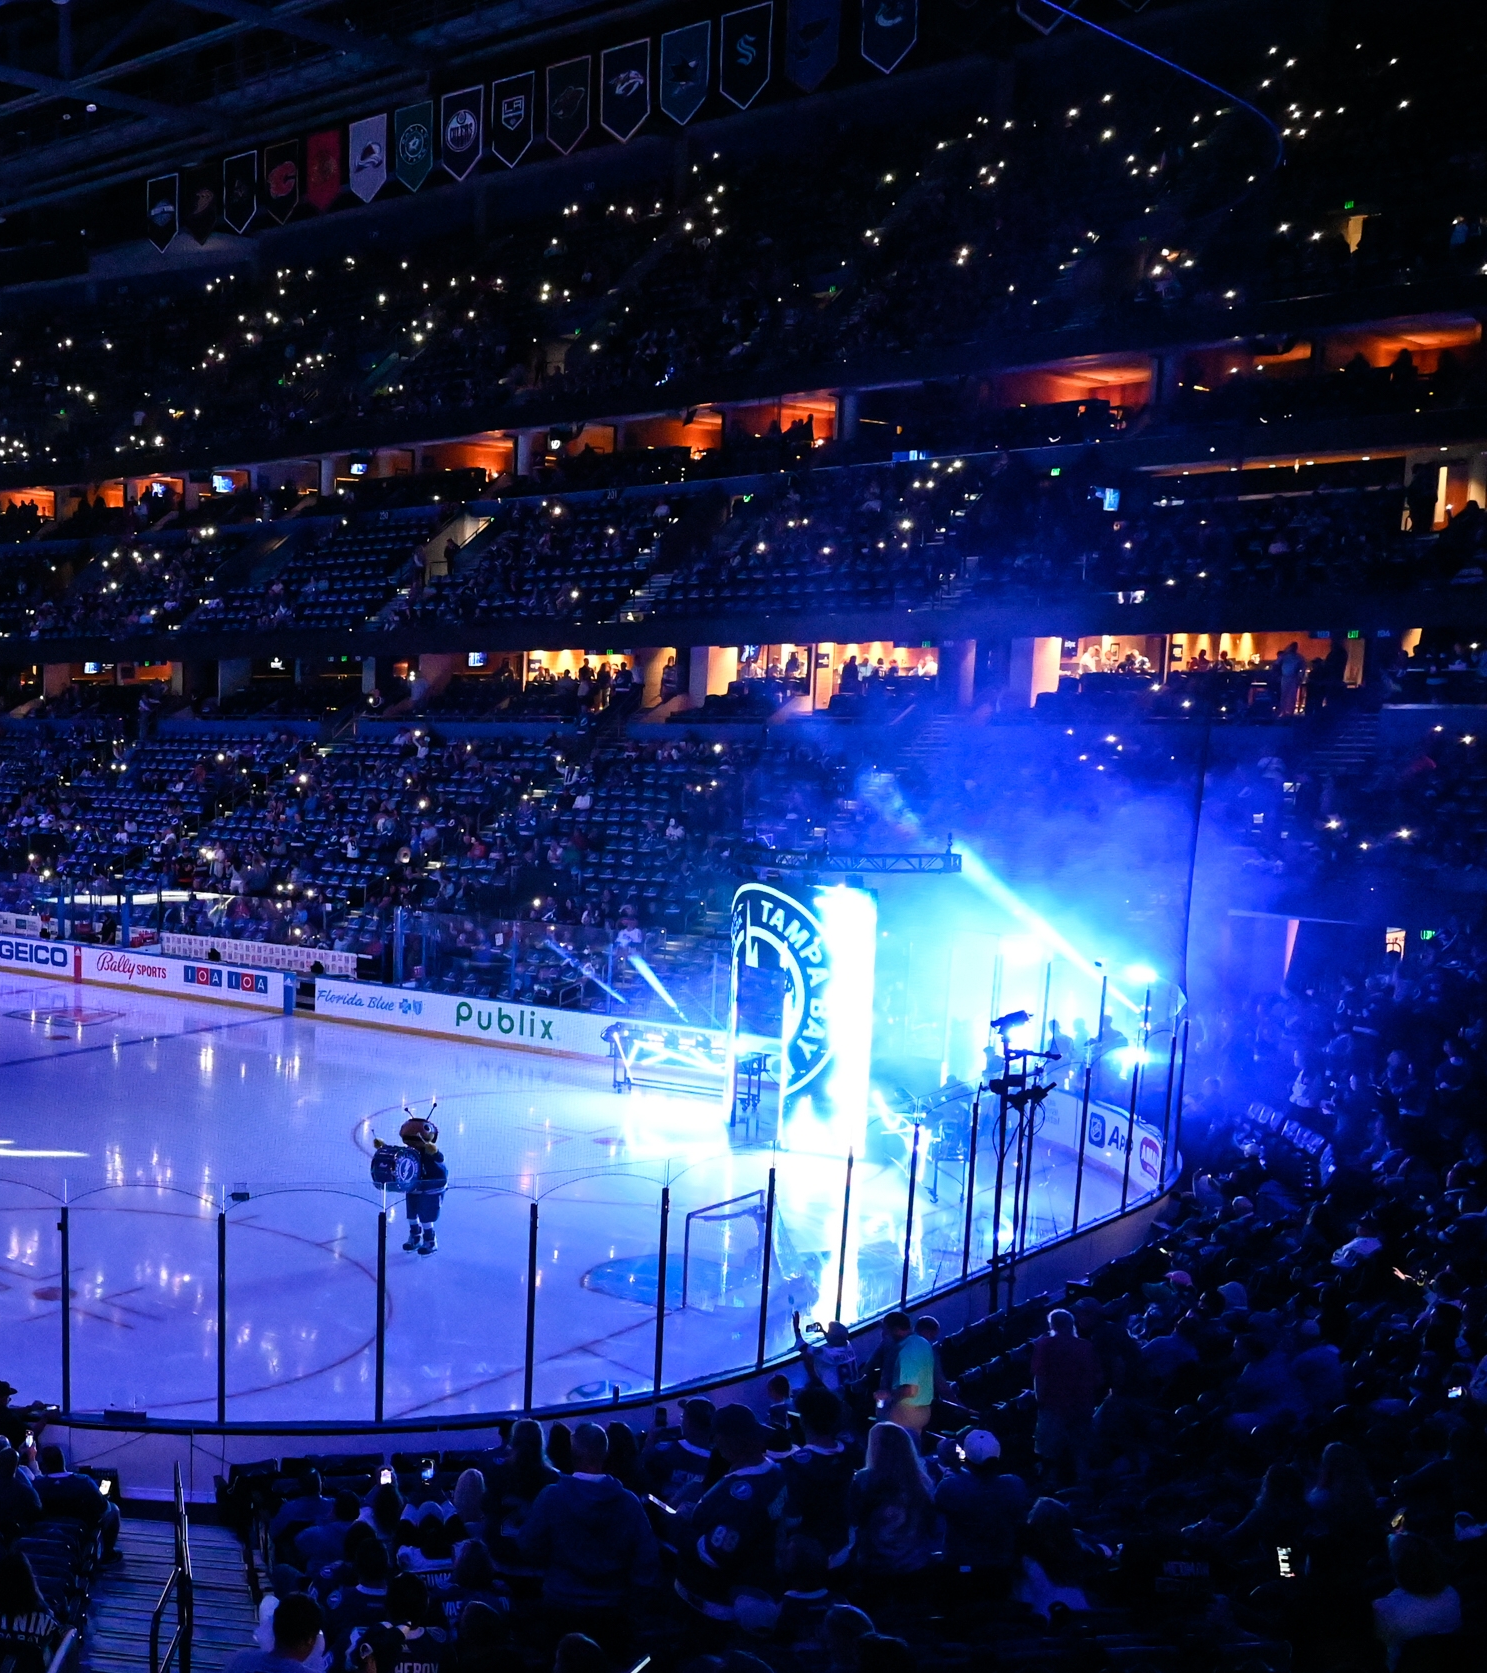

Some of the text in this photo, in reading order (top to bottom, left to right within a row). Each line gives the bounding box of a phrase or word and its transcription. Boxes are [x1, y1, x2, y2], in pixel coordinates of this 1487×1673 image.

[97, 952, 167, 979] Bally SPORTS
[184, 966, 222, 987] IOA
[228, 971, 268, 993] IOA
[761, 900, 829, 1061] TAMPA BAY
[317, 990, 394, 1011] Florida Blue
[456, 1001, 553, 1041] Publix
